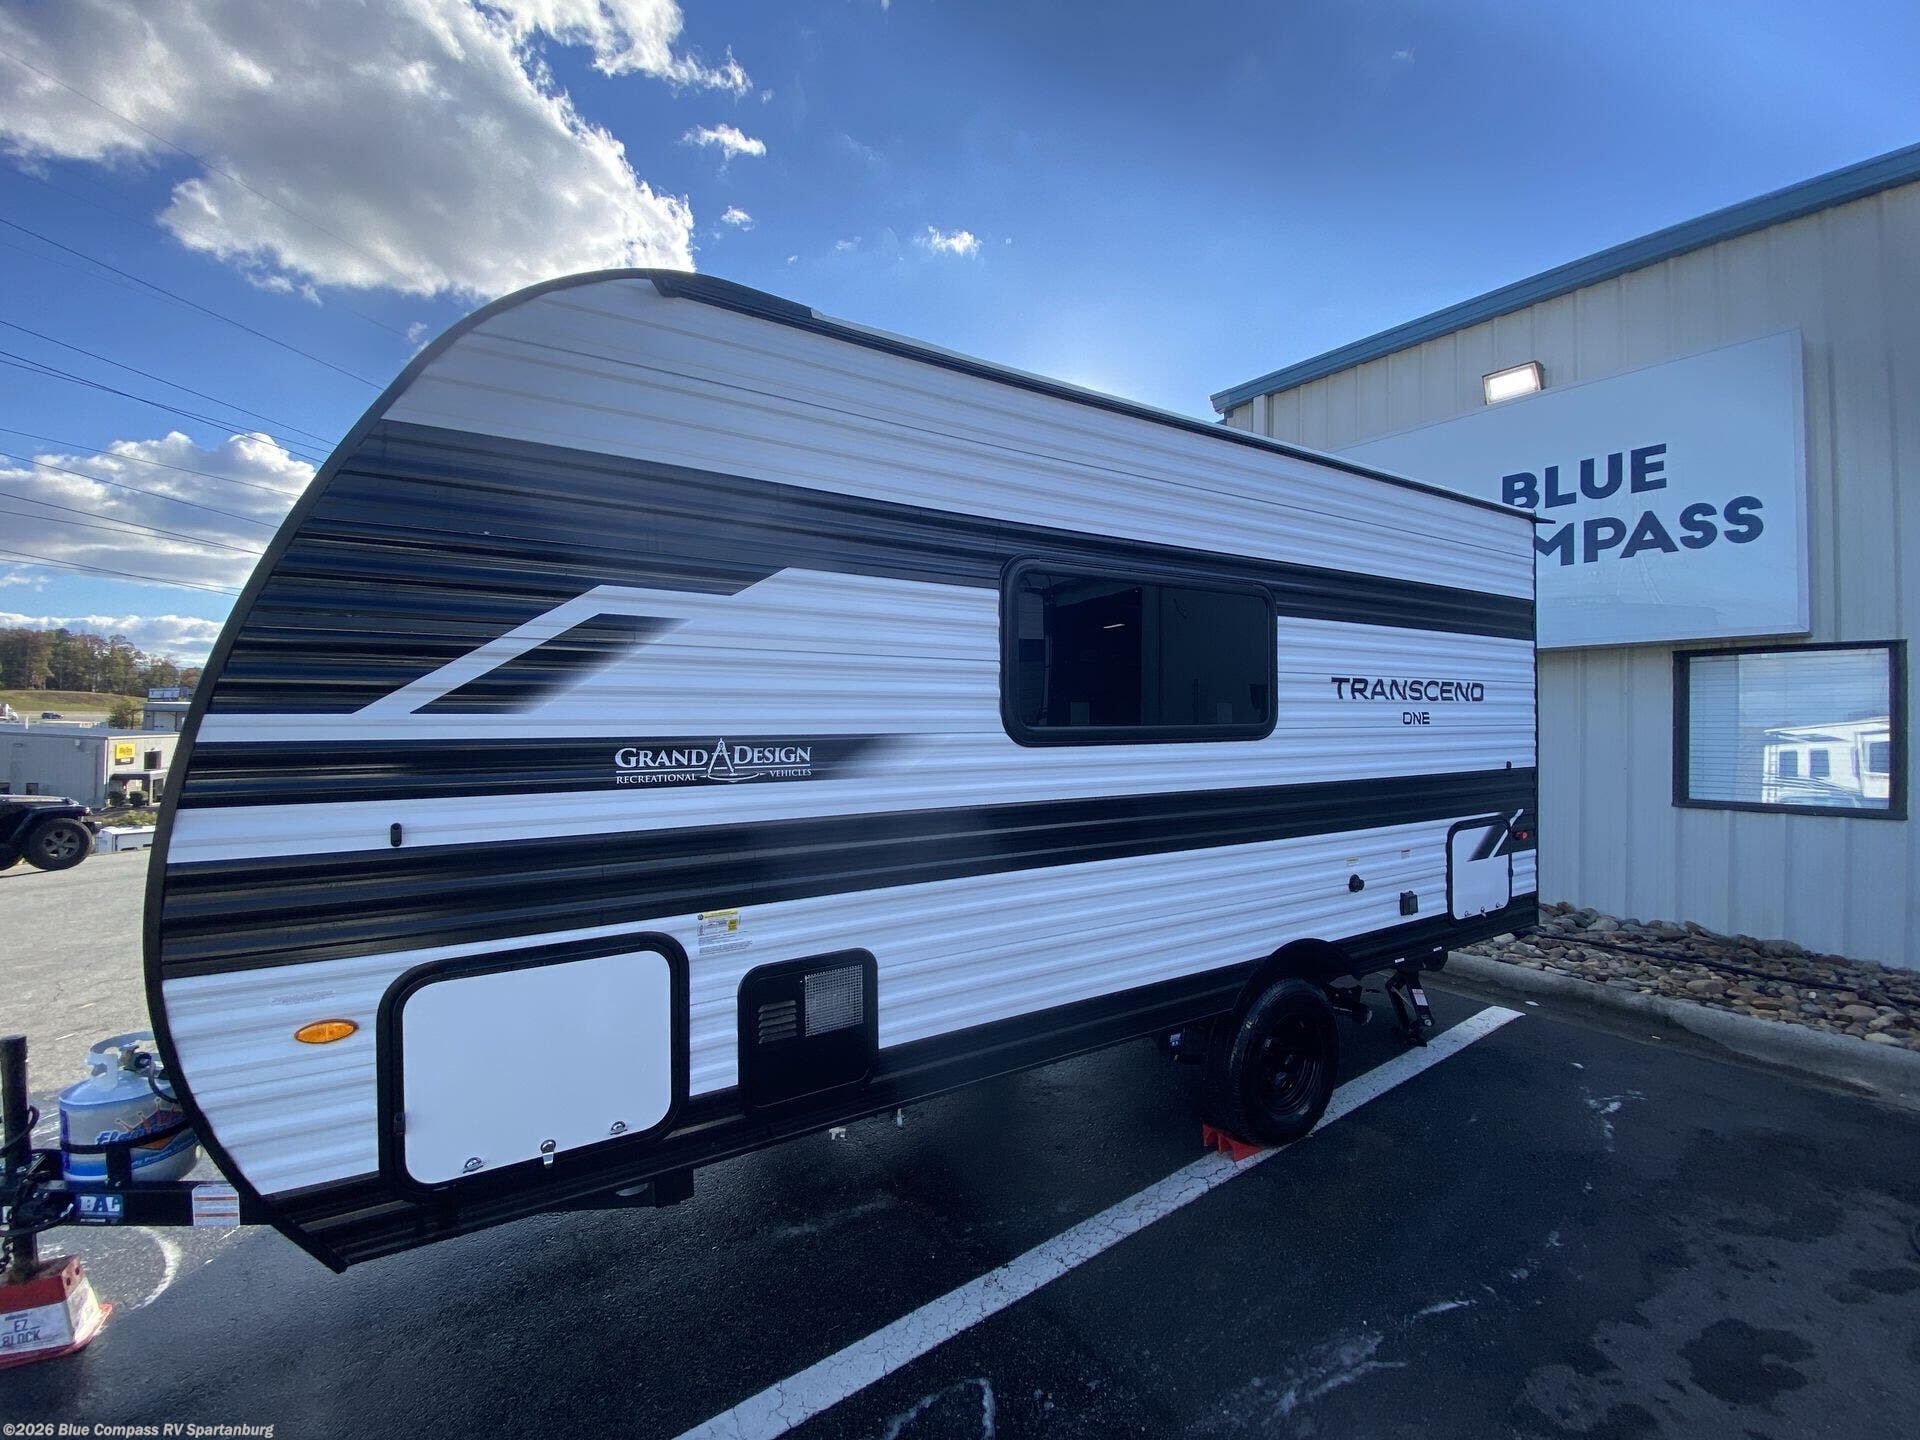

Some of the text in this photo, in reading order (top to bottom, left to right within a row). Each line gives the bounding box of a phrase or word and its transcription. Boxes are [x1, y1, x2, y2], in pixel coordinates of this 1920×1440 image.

[1502, 443, 1667, 509] BLUE
[1535, 496, 1764, 567] MPASS
[1331, 677, 1485, 702] TRANSCEND
[1402, 711, 1431, 725] ONE
[614, 745, 813, 768] GRAND DESIGN
[616, 768, 812, 785] RECREATIONAL VEHICLES
[14, 1318, 28, 1333] EZ
